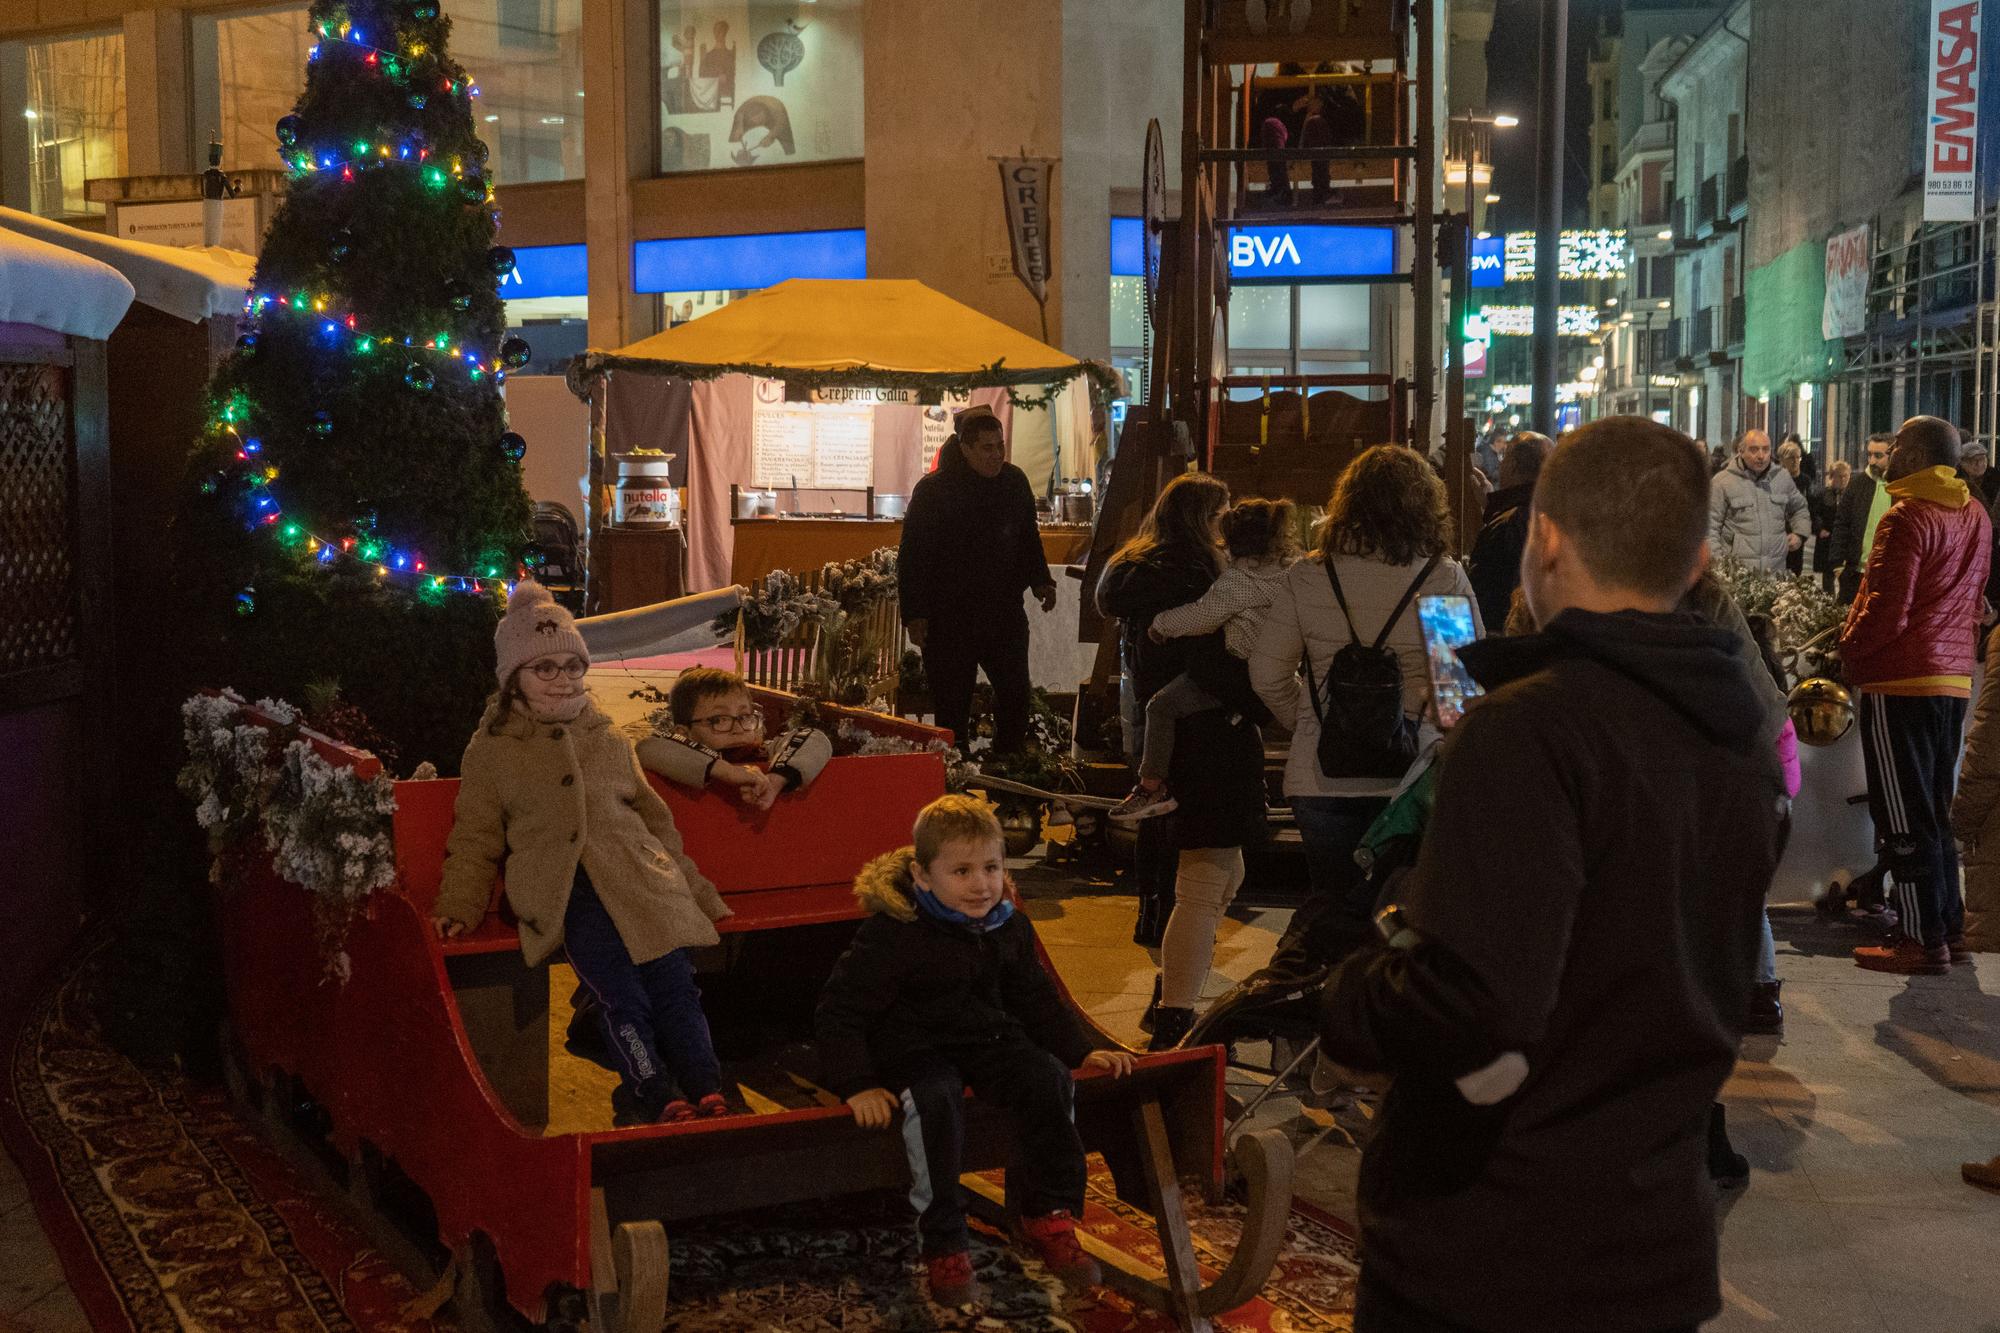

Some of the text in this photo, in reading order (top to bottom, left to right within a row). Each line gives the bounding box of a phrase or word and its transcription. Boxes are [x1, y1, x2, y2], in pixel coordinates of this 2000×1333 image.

[1932, 1, 1978, 173] EMASA
[1927, 180, 1973, 190] 980 53 86 13
[1012, 166, 1044, 283] CREPES
[1228, 232, 1301, 268] BVA
[1471, 254, 1501, 271] BVA
[624, 487, 668, 503] nutella
